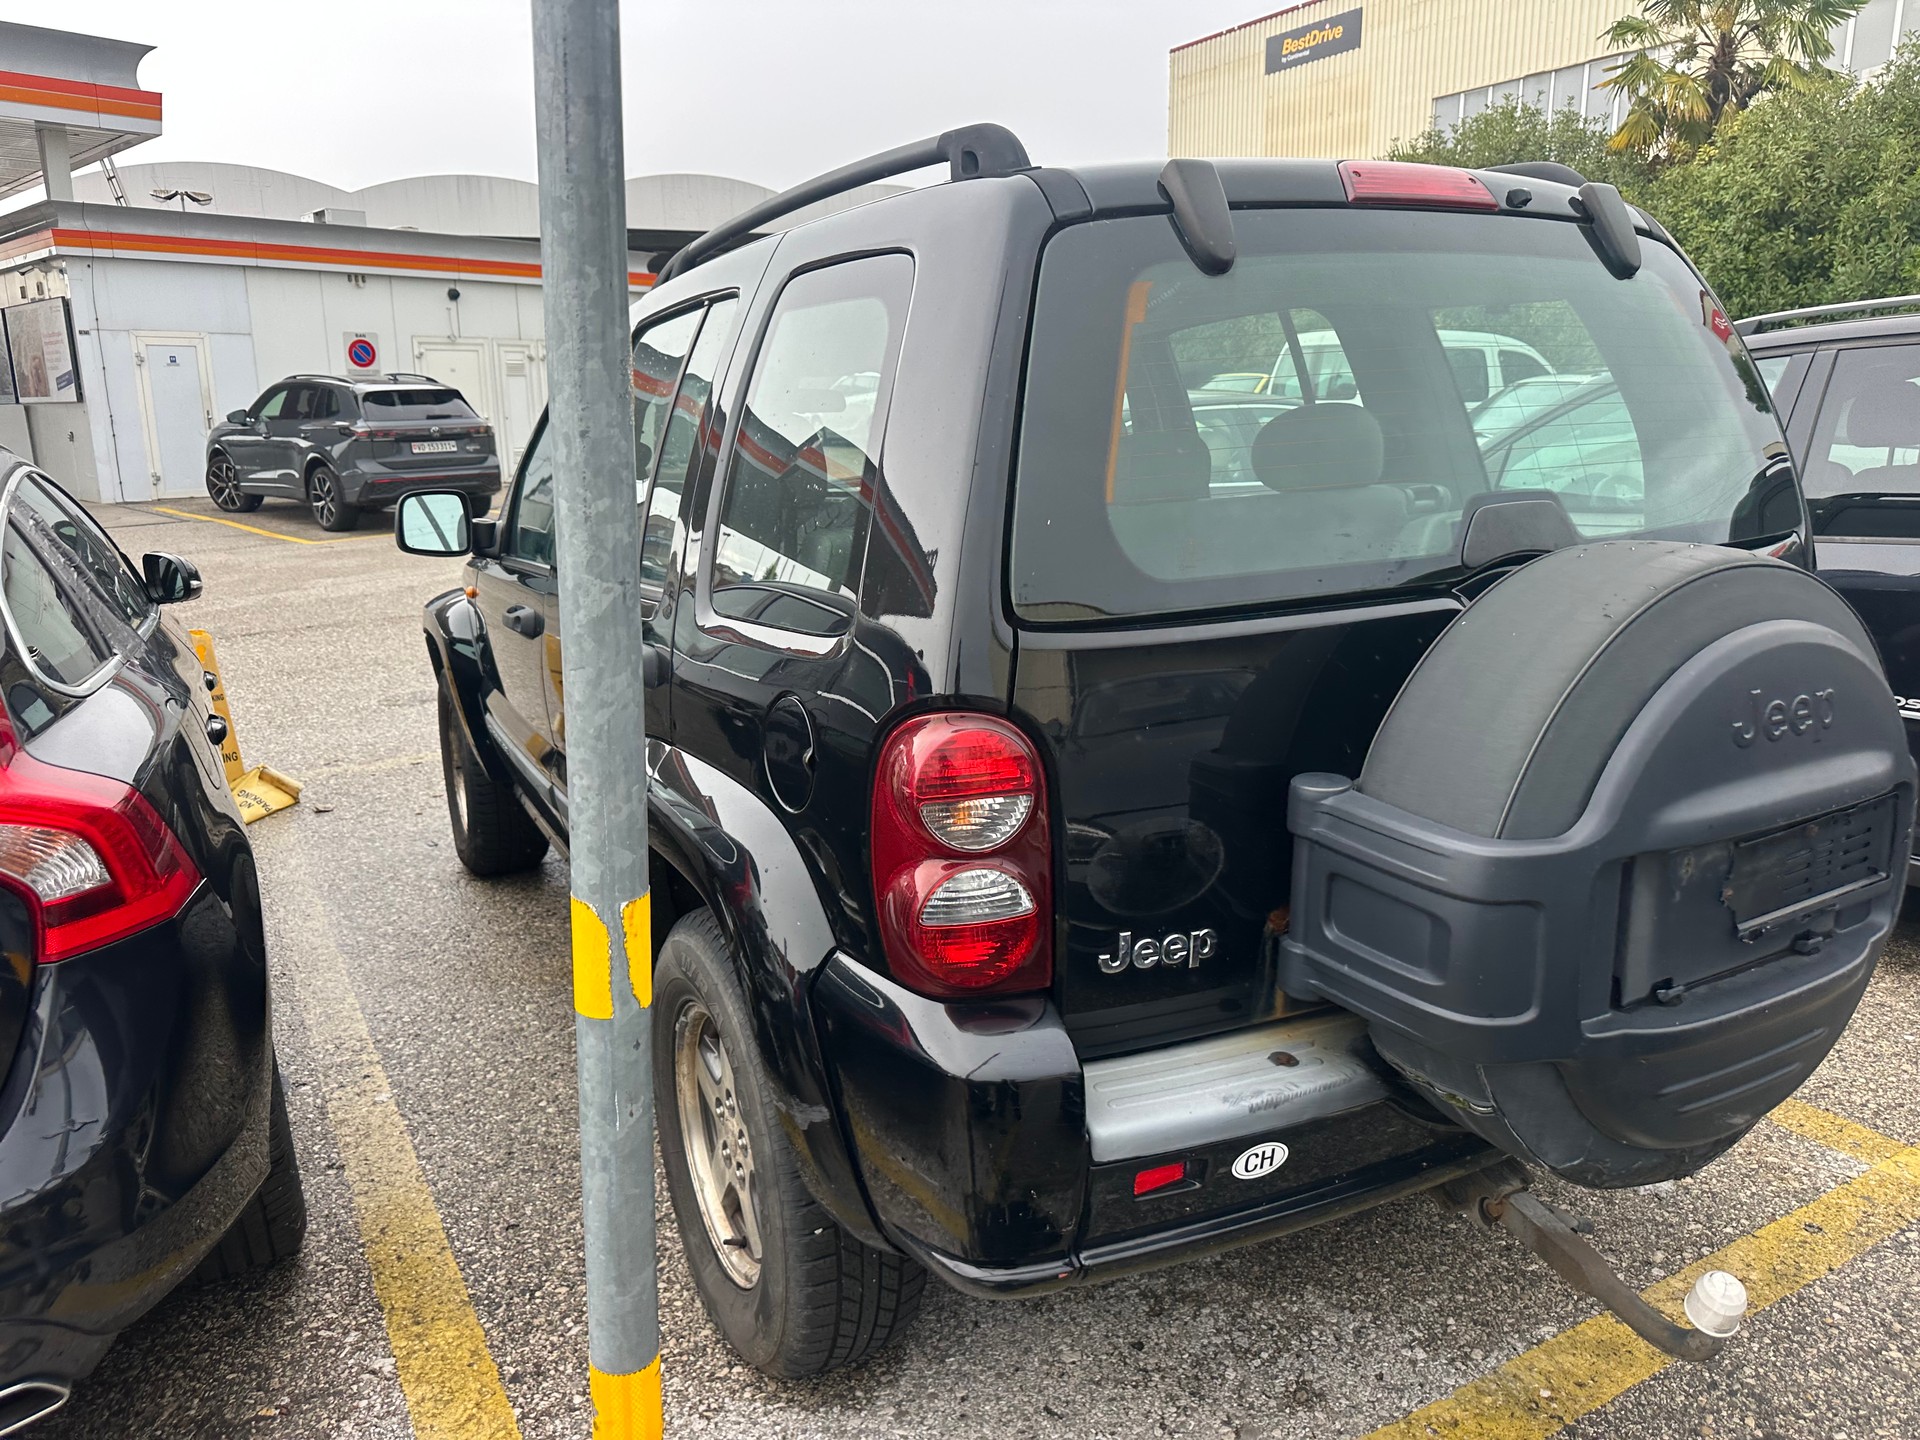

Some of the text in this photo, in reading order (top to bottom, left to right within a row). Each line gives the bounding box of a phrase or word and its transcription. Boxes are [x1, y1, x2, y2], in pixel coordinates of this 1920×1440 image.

[1282, 23, 1343, 55] BestDrive
[1732, 688, 1834, 749] Jeep
[237, 789, 273, 813] PARKING
[239, 800, 255, 809] NO
[1098, 928, 1217, 974] Jeep
[1244, 1148, 1276, 1173] CH
